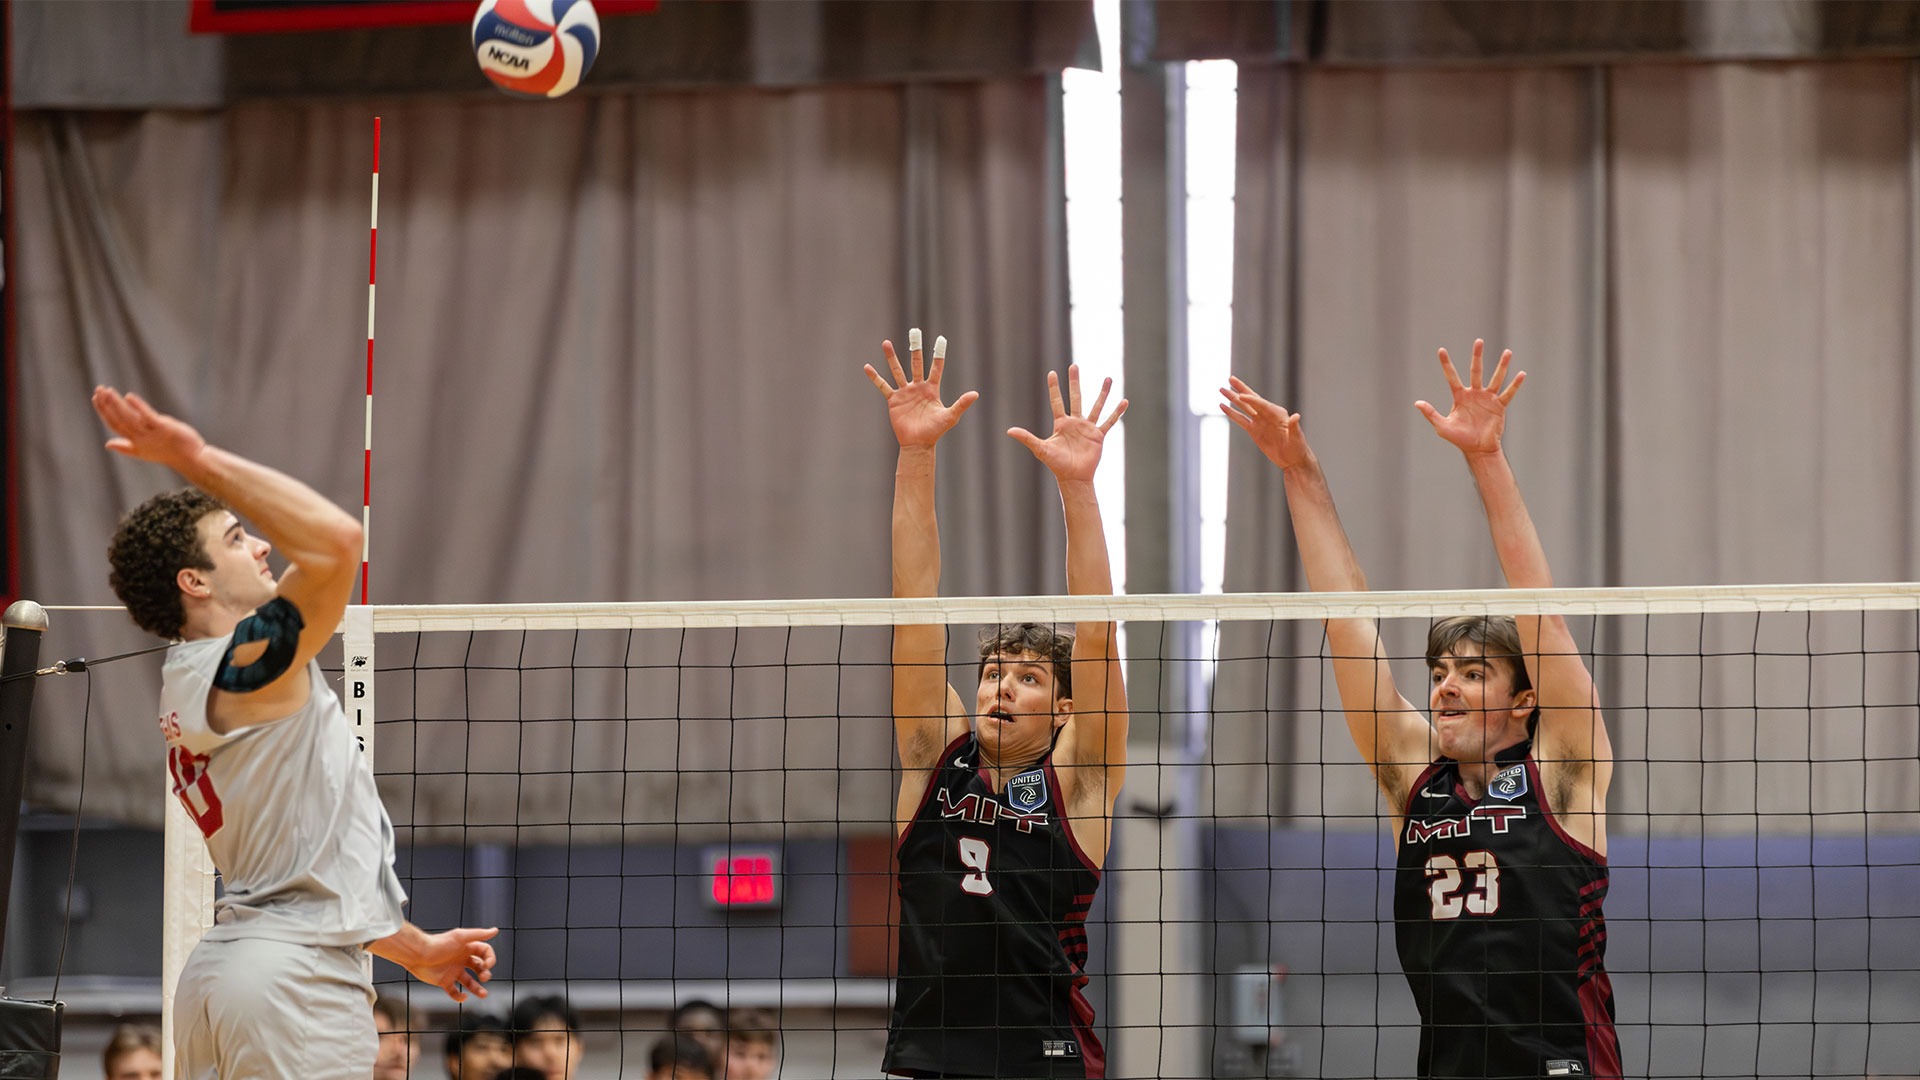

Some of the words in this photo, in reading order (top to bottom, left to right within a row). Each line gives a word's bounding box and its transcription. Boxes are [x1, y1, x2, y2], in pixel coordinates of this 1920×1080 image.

[488, 46, 530, 71] NCAA
[1011, 774, 1041, 785] UNITED
[937, 788, 1049, 834] MIT
[1407, 805, 1527, 844] MIT
[958, 835, 994, 897] 9
[1424, 850, 1501, 919] 23
[1068, 1045, 1074, 1053] L
[1571, 1063, 1581, 1071] XL
